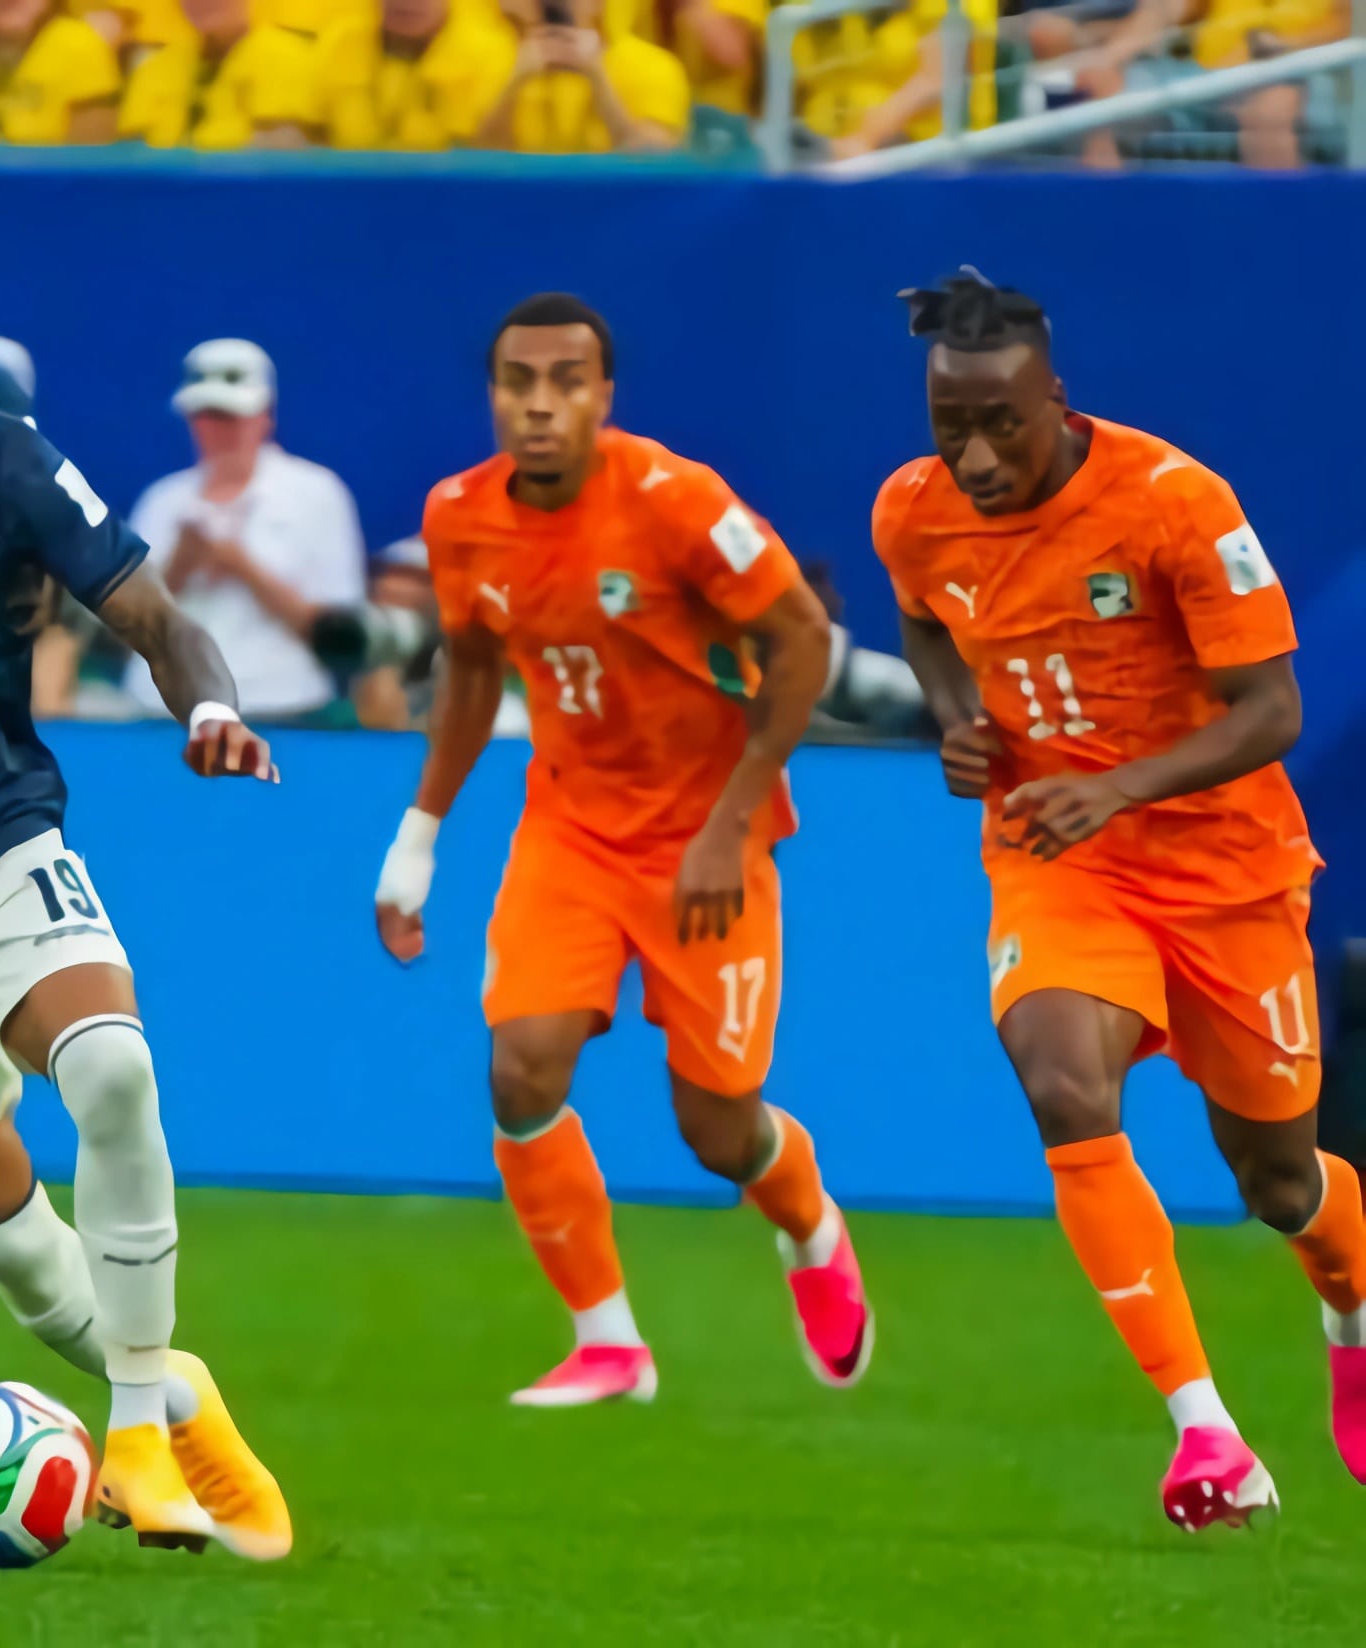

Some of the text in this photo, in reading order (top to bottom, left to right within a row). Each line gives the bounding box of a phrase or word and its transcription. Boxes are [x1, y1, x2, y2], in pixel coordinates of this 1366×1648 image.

[542, 645, 604, 720] 17
[1007, 653, 1096, 740] 11
[27, 858, 99, 923] 19
[717, 956, 766, 1034] 17
